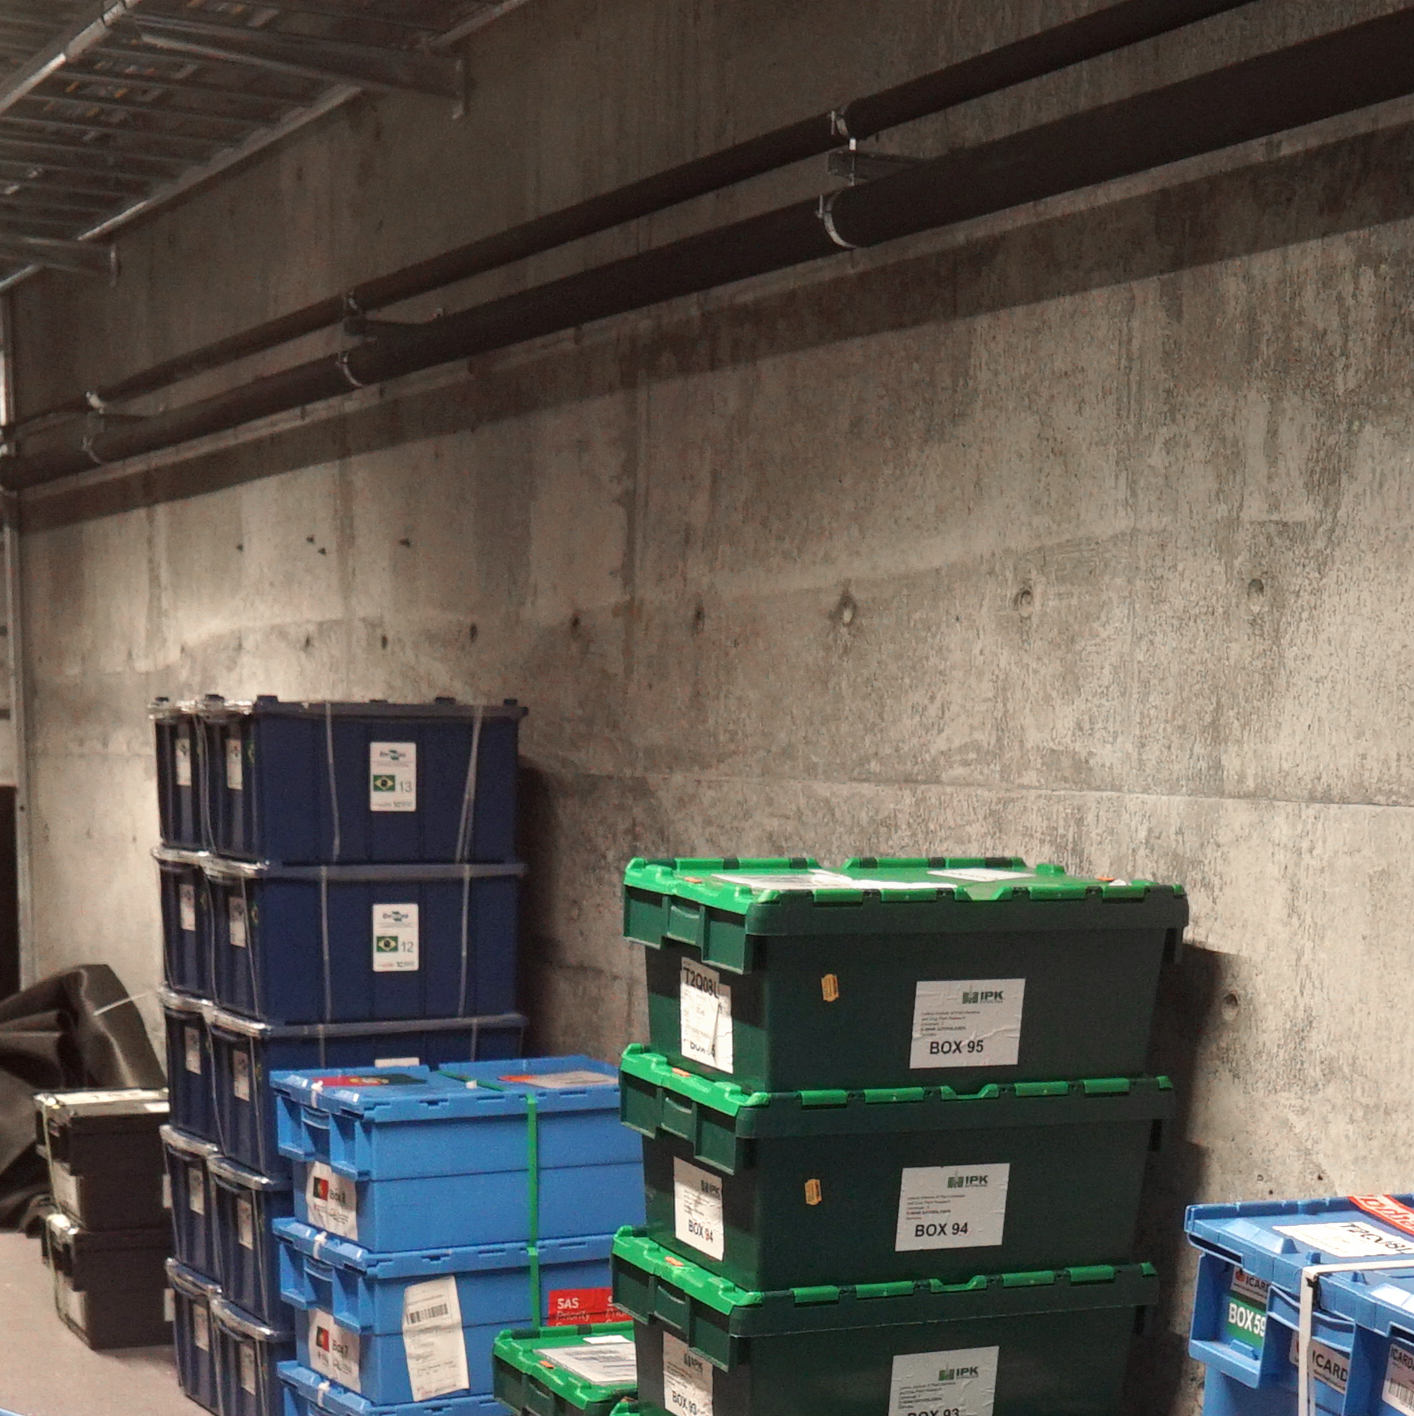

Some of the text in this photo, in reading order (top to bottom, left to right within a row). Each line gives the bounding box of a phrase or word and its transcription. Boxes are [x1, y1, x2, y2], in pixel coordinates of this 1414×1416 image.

[400, 781, 412, 793] 13
[401, 941, 414, 953] 12
[980, 990, 1004, 1000] IPK
[930, 1039, 984, 1055] BOX 95
[966, 1174, 989, 1185] IPK
[688, 1218, 703, 1239] BOX
[915, 1221, 969, 1237] BOX 94
[557, 1297, 580, 1310] SAS
[1229, 1302, 1268, 1337] BOX 59
[956, 1366, 979, 1377] IPK
[1312, 1349, 1348, 1382] ICARD
[672, 1389, 687, 1409] BOX
